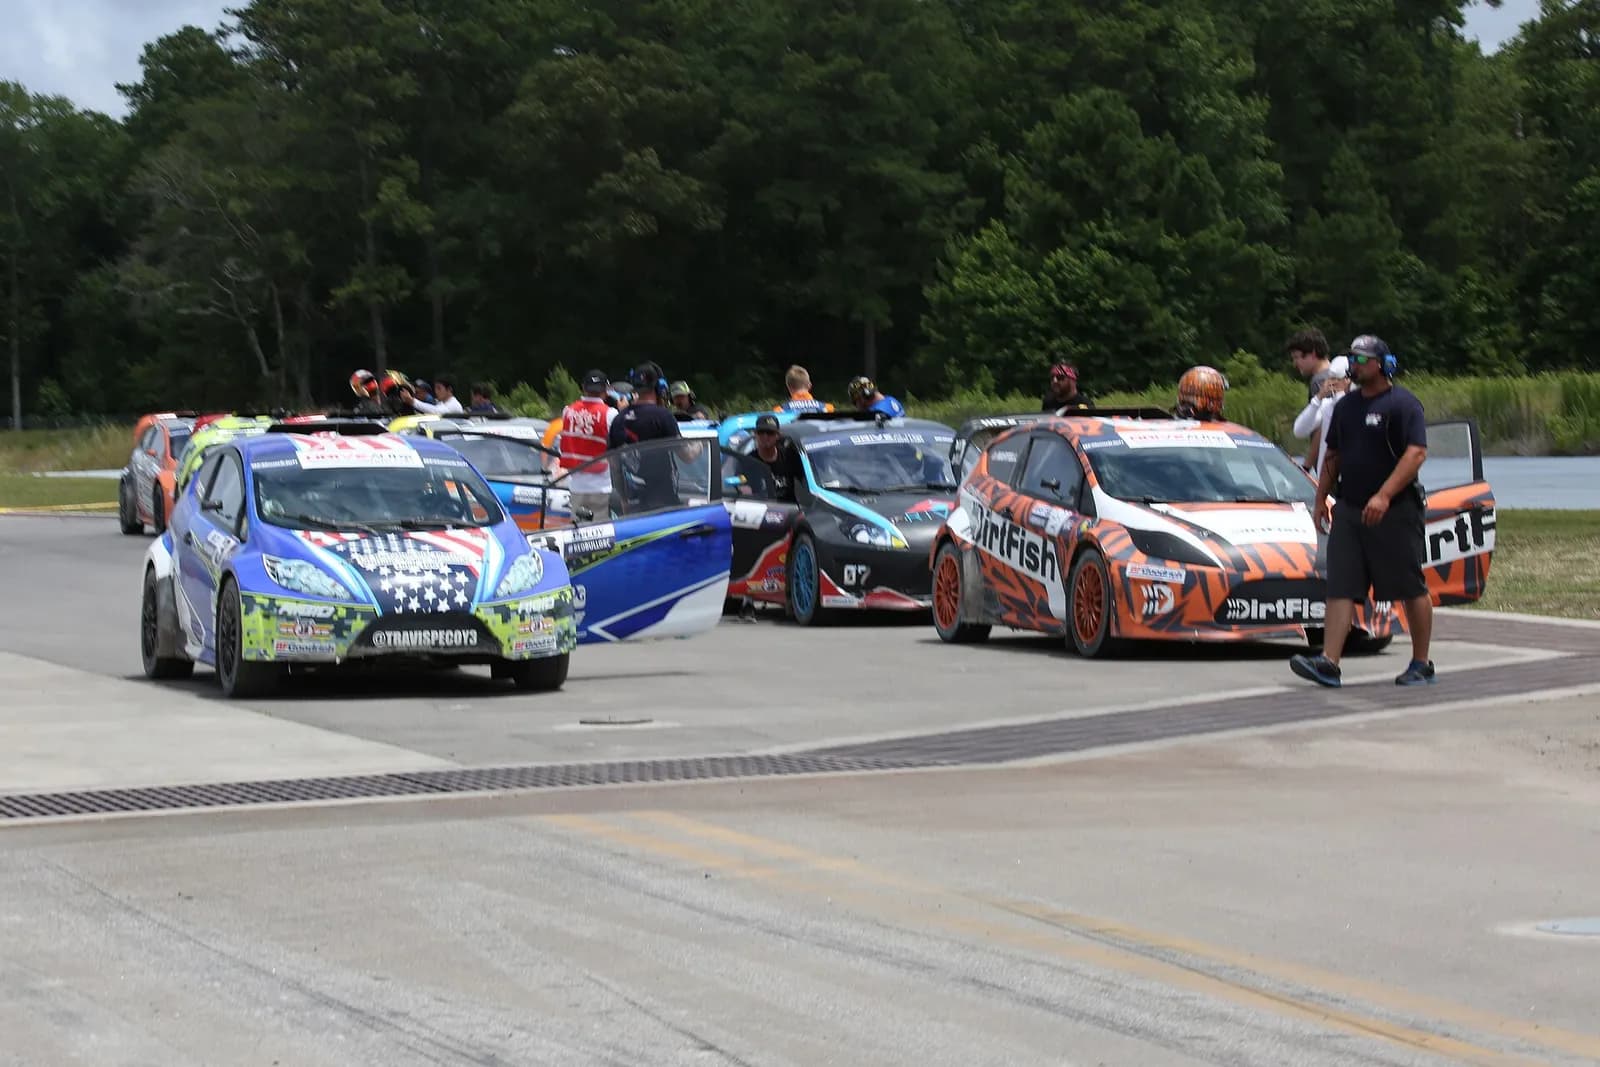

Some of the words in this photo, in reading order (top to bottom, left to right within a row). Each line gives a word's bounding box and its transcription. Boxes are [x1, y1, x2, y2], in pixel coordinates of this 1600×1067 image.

[843, 563, 871, 586] 07
[1227, 598, 1326, 620] DirtFis
[372, 628, 479, 647] @TRAVISPECOY3
